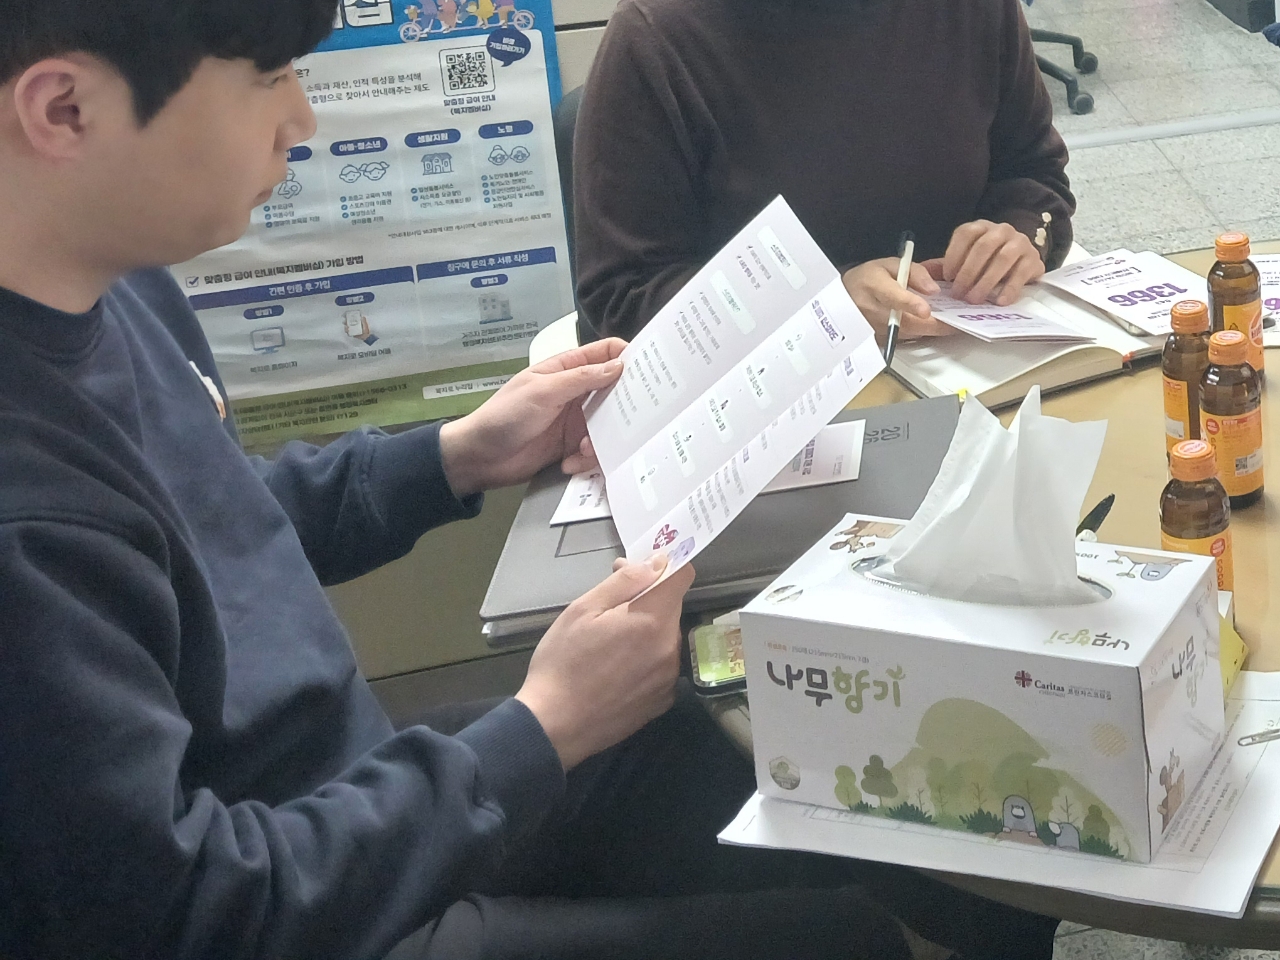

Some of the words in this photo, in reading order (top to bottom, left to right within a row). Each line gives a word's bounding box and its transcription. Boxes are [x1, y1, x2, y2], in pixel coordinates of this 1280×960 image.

[1107, 282, 1188, 307] 1366
[1043, 629, 1130, 650] 나무향기
[766, 661, 906, 714] 나무향기
[1035, 679, 1065, 692] Caritas
